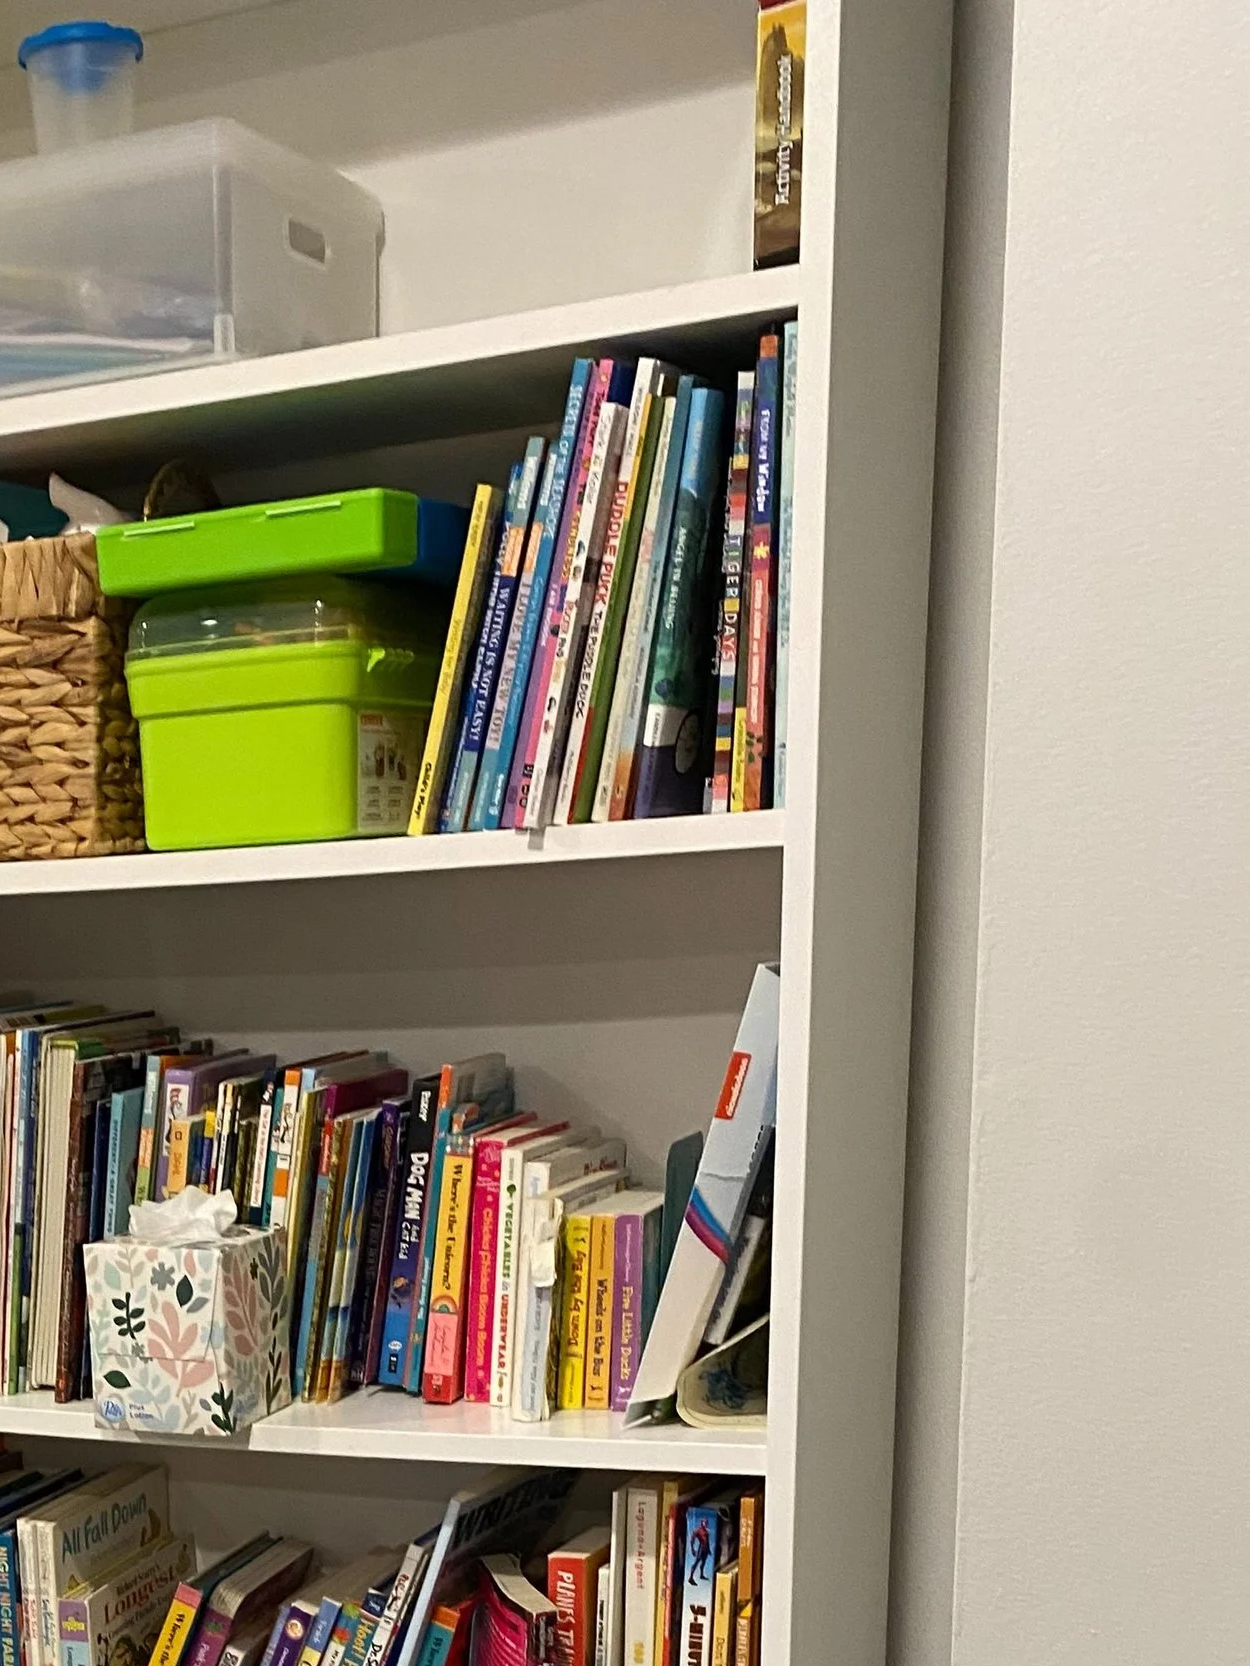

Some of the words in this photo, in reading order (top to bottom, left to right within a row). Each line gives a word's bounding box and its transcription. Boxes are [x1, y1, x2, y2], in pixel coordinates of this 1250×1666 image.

[755, 462, 770, 512] Window
[603, 480, 628, 557] DUDDLE
[673, 526, 688, 564] ANGEL
[593, 560, 613, 604] PUCK
[724, 535, 742, 599] TIGER
[487, 586, 510, 649] WAITING
[720, 612, 737, 661] DAYS
[483, 651, 497, 667] IS
[477, 667, 494, 697] NOT
[573, 683, 589, 718] DUCK
[468, 699, 487, 742] EASY!
[406, 1149, 428, 1183] DOG
[401, 1187, 423, 1220] MAN
[447, 1163, 464, 1212] Where's
[399, 1221, 411, 1242] CAT
[445, 1215, 458, 1234] the
[480, 1207, 492, 1250] Chicka
[501, 1202, 514, 1278] VEGETABLES
[440, 1235, 456, 1290] Unicorn?
[573, 1250, 586, 1271] Bay
[570, 1274, 582, 1293] the
[595, 1278, 607, 1317] Wheels
[621, 1286, 633, 1309] Five
[476, 1293, 487, 1330] Boom
[572, 1297, 583, 1312] by
[496, 1294, 509, 1369] UNDERWEAR
[567, 1315, 580, 1346] Down
[594, 1319, 603, 1333] on
[620, 1311, 632, 1344] Little
[475, 1330, 486, 1366] Boom
[593, 1336, 604, 1354] the
[618, 1346, 632, 1380] Ducks
[593, 1357, 604, 1376] Bus
[62, 1528, 80, 1564] All
[84, 1509, 109, 1550] Fall
[111, 1492, 147, 1534] Down
[105, 1566, 174, 1624] Longest
[554, 1569, 576, 1623] PLANES
[163, 1611, 185, 1651] Where's
[348, 1617, 376, 1660] Hoot!
[158, 1650, 170, 1666] the
[331, 1649, 340, 1660] My
[368, 1642, 383, 1658] Dr.
